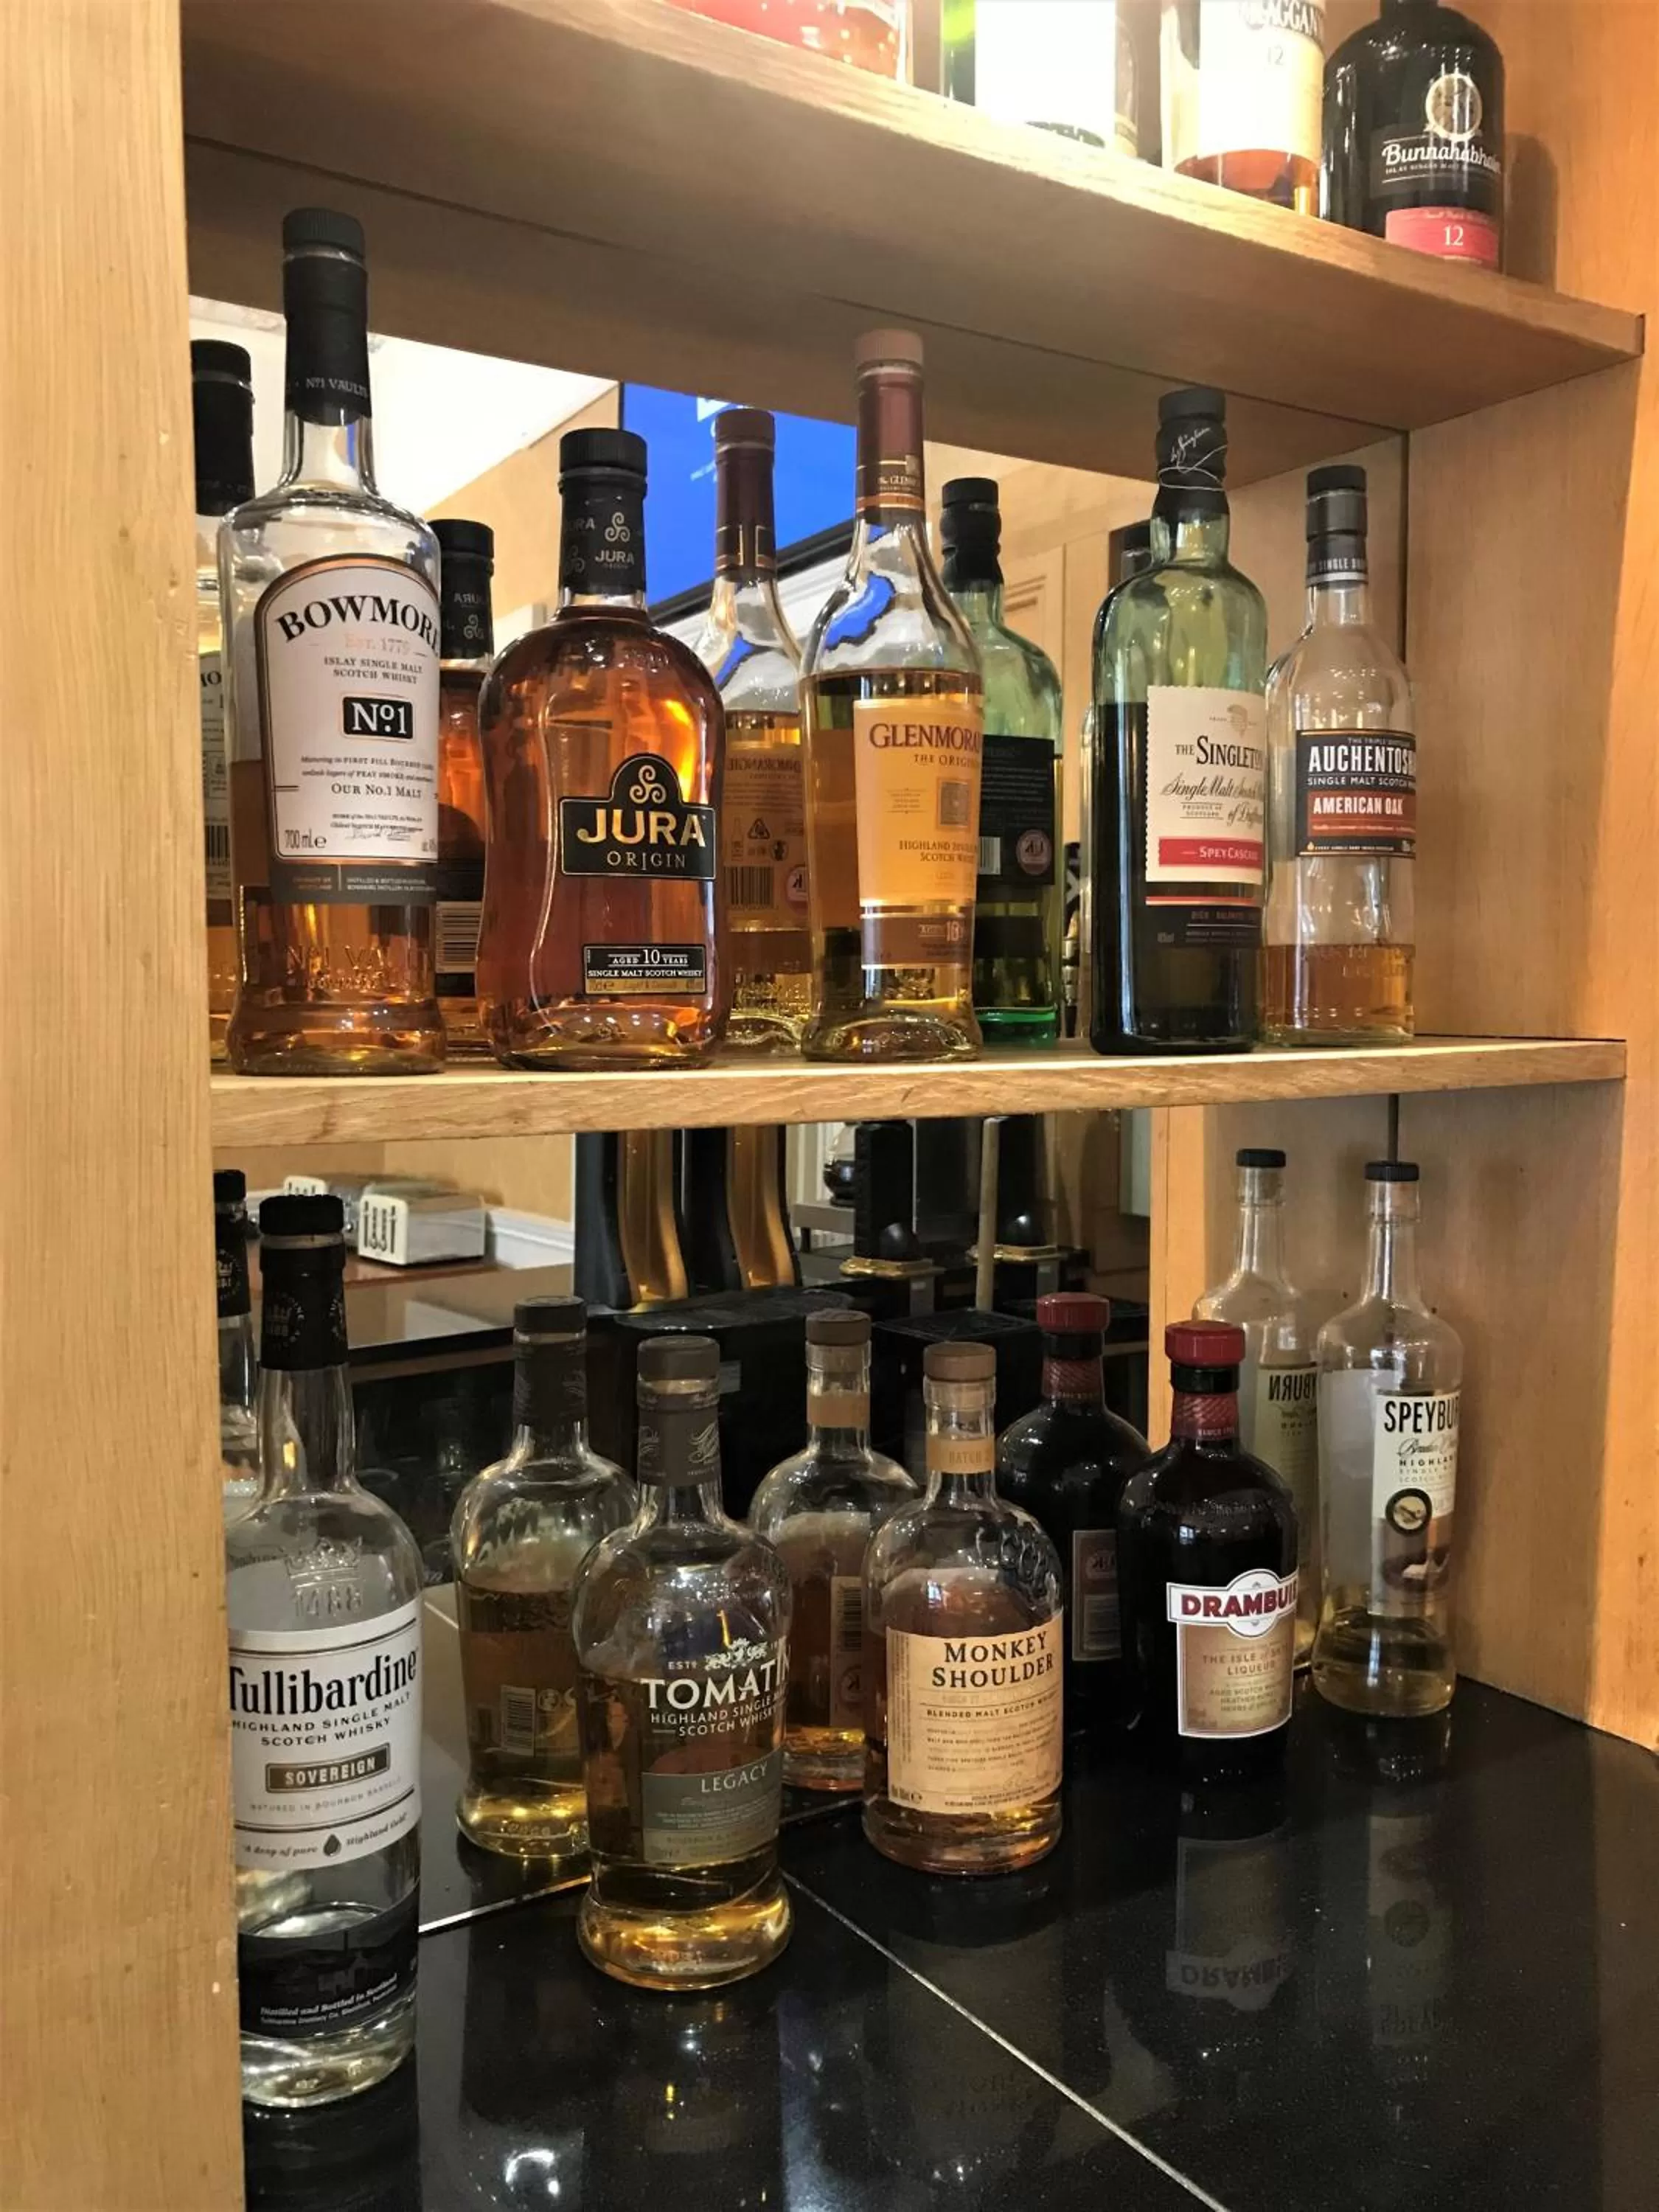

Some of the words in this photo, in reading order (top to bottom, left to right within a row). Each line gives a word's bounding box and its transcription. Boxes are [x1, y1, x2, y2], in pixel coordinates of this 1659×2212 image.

[1382, 142, 1502, 174] Bunnahabha
[1444, 225, 1464, 246] 12
[594, 549, 635, 565] JURA
[324, 656, 357, 667] ISLAY
[361, 658, 397, 669] SINGLE
[400, 664, 423, 674] MALT
[333, 669, 378, 679] SCOTCH
[382, 672, 417, 684] WHISKY
[914, 753, 935, 764] THE
[939, 754, 979, 769] ORIGI
[1175, 744, 1195, 756] THE
[1197, 735, 1263, 772] SINGLET
[1308, 745, 1415, 775] AUCHENTOS
[332, 782, 361, 795] OUR
[395, 786, 422, 799] MALT
[1307, 776, 1346, 786] SINGLE
[1350, 776, 1376, 786] MALT
[1312, 796, 1382, 815] AMERICAN
[1385, 797, 1404, 815] OAK
[577, 808, 706, 848] JURA
[899, 840, 950, 851] HIGHLAND
[607, 850, 686, 871] ORIGIN
[920, 852, 955, 862] SCOTCH
[642, 949, 661, 965] 10
[663, 957, 689, 965] YEARS
[588, 969, 619, 978] SINGLE
[622, 969, 643, 978] MALT
[644, 969, 677, 978] SCOTCH
[944, 1630, 1048, 1663] MONKEY
[1203, 1655, 1224, 1664] THE
[1231, 1652, 1256, 1663] ISLE
[1227, 1659, 1276, 1676] LIQUEUR
[640, 1635, 791, 1710] TOMATIN
[931, 1652, 1054, 1688] SHOULDER
[229, 1649, 417, 1715] Tullibardine
[232, 1719, 315, 1732] HIGHLAND
[322, 1707, 378, 1730] SINGLE
[384, 1691, 411, 1712] MALT
[650, 1709, 728, 1725] HIGHLAND
[732, 1695, 772, 1719] SINGLE
[927, 1709, 971, 1719] BLENDED
[975, 1708, 1000, 1718] MALT
[1004, 1701, 1035, 1715] SCOTCH
[261, 1734, 327, 1747] SCOTCH
[334, 1717, 391, 1741] WHISKY
[678, 1720, 735, 1737] SCOTCH
[285, 1757, 376, 1786] SOVEREIGN
[700, 1762, 769, 1793] LEGACY
